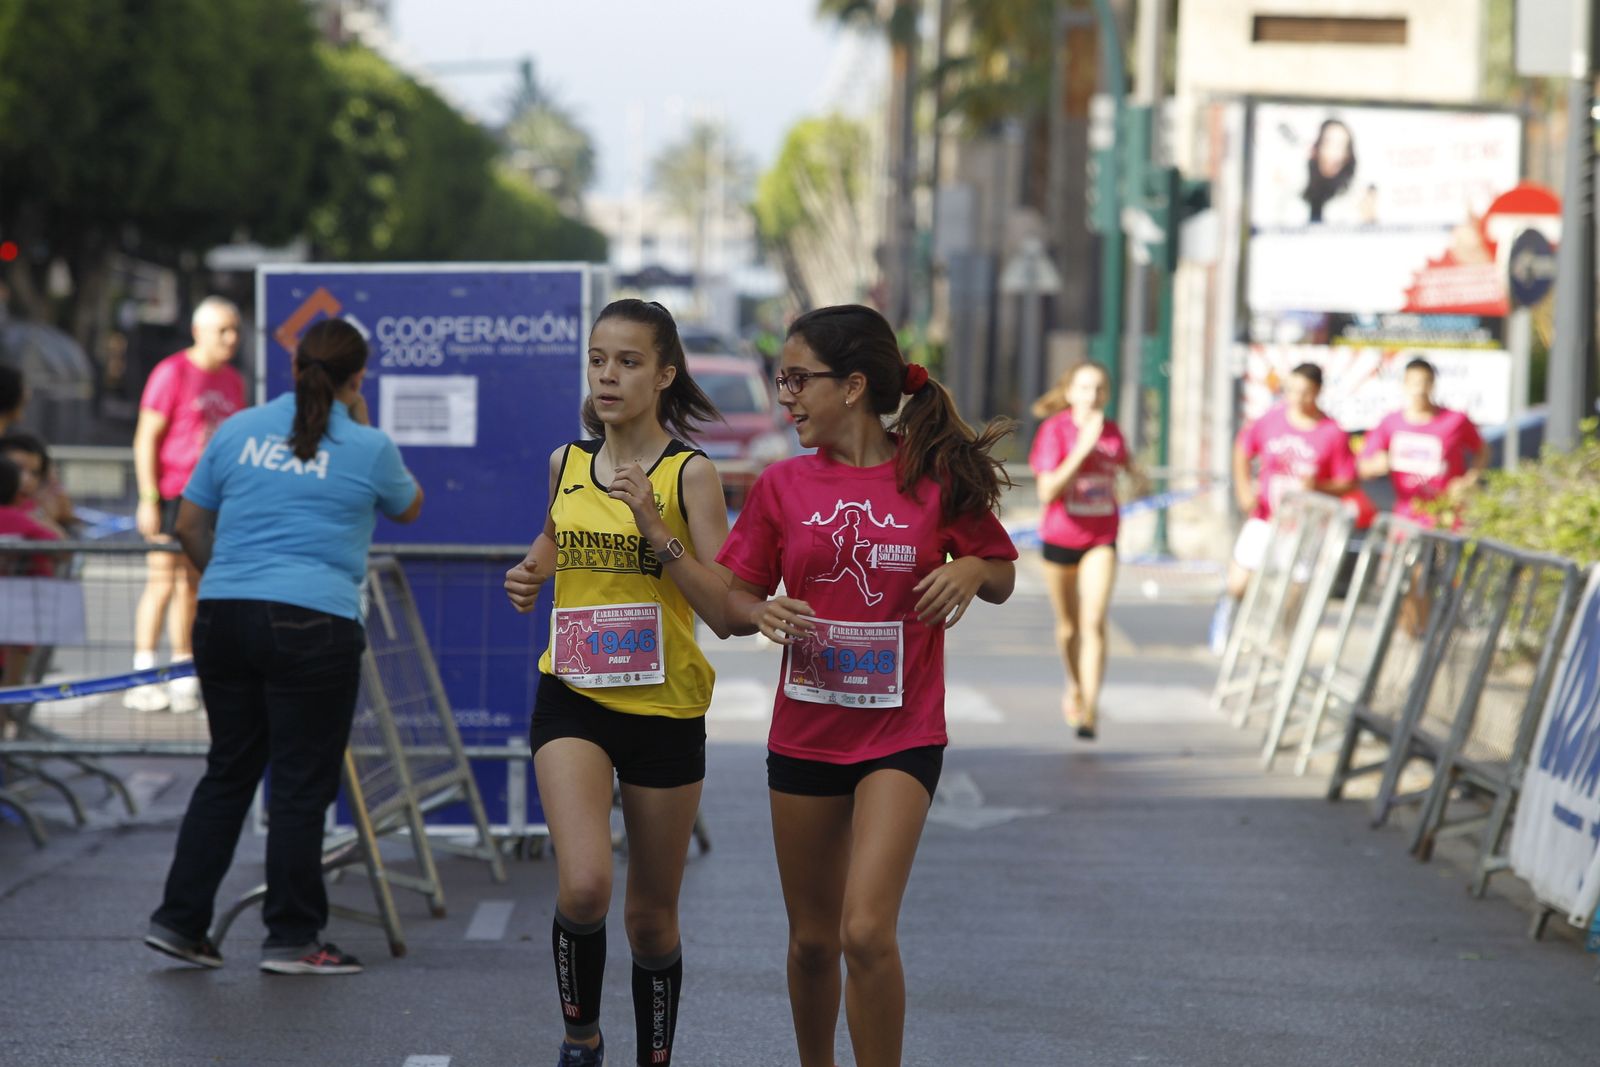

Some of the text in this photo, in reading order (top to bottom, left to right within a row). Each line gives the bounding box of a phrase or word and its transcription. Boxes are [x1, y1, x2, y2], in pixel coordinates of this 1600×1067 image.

[376, 311, 578, 344] COOPERACIÓN
[380, 343, 445, 368] 2005
[556, 530, 639, 553] UNNERS
[878, 543, 917, 555] CARRERA
[556, 548, 640, 569] OREVER
[878, 552, 916, 563] SOLIDARIA
[596, 609, 624, 618] CARRERA
[624, 608, 656, 617] SOLIDARIA
[833, 626, 863, 637] CARRERA
[863, 627, 897, 637] SOLIDARIA
[586, 629, 656, 655] 1946
[608, 656, 631, 664] PAULY
[821, 647, 895, 674] 1948
[843, 676, 868, 685] LAURA
